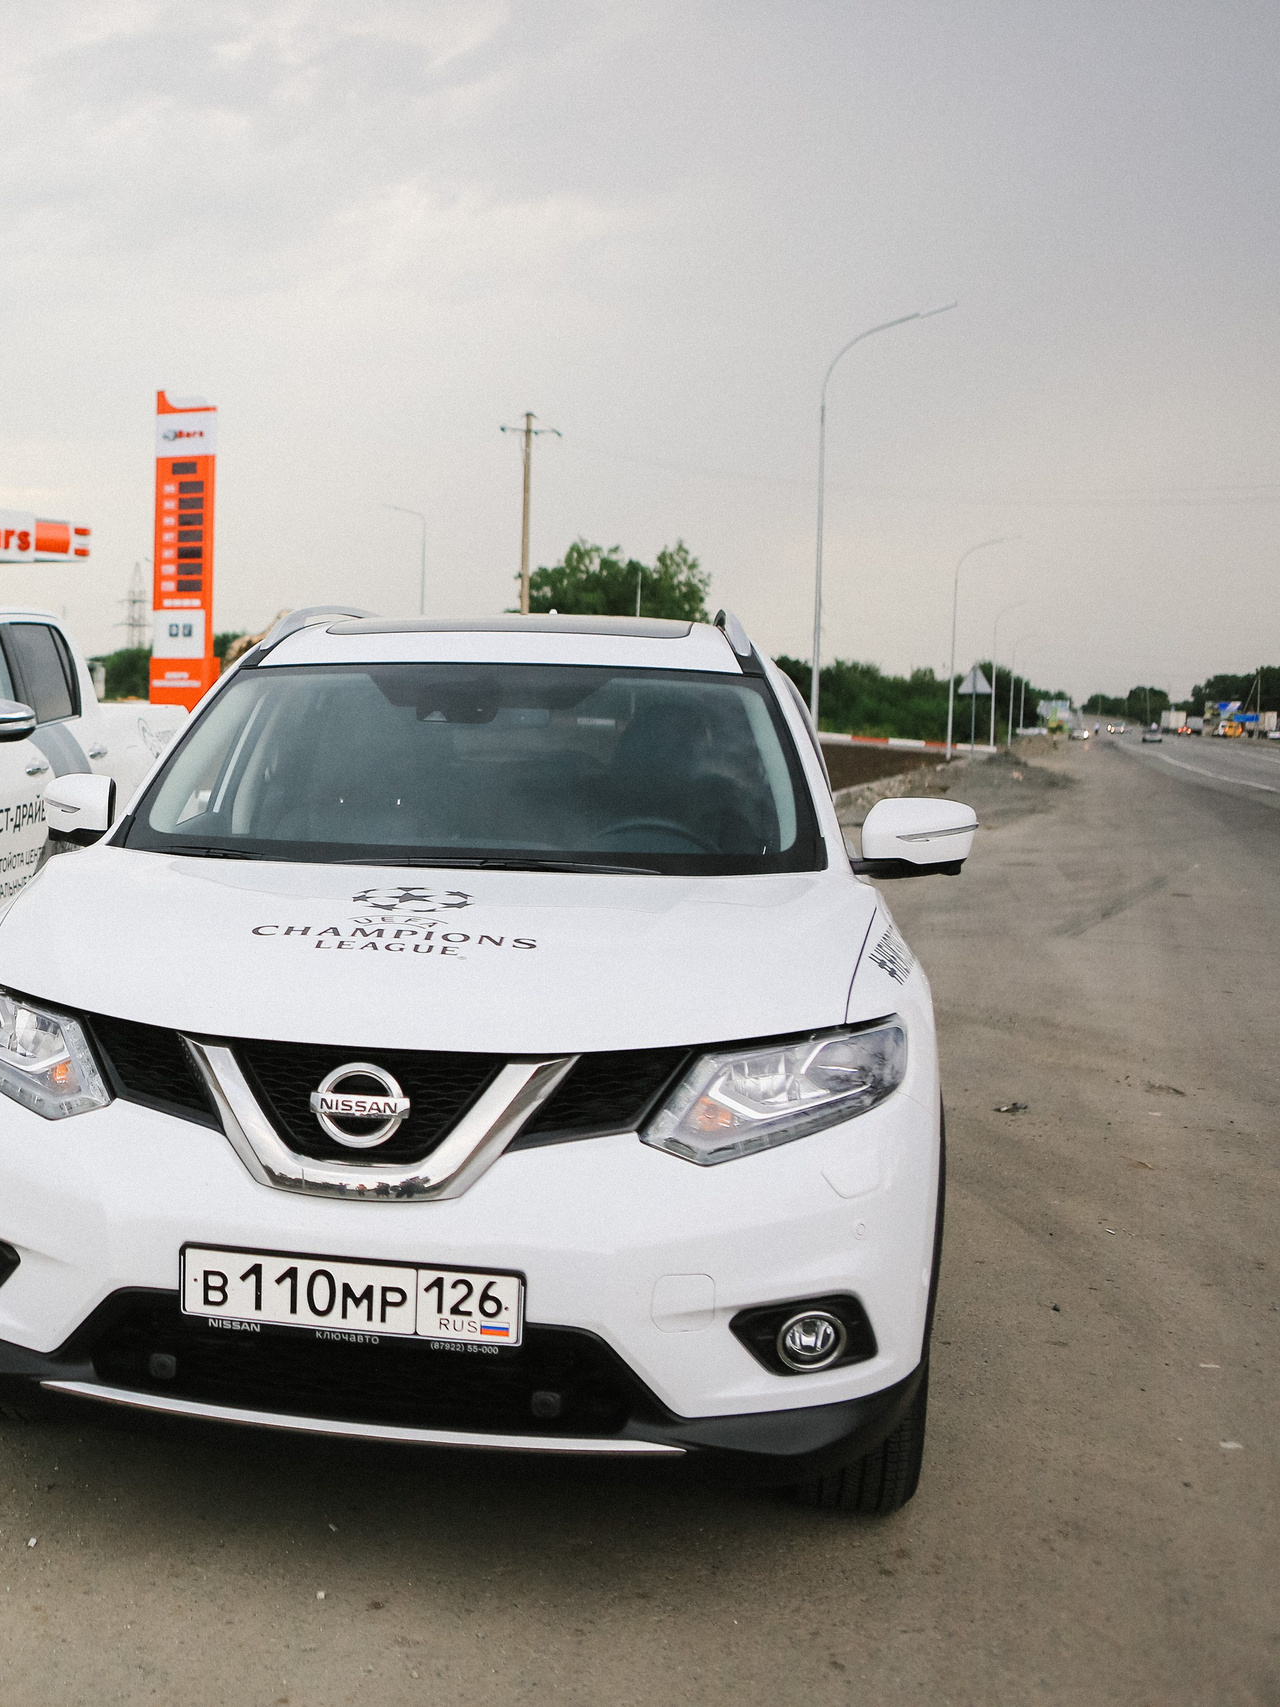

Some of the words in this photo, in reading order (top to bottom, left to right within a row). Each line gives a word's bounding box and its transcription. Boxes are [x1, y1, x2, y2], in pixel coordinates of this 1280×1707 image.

[353, 916, 437, 928] UEFA
[251, 925, 538, 950] CHAMPIONS
[315, 939, 460, 957] LEAGUE
[320, 1097, 397, 1114] NISSAN
[202, 1263, 408, 1323] В110МР
[423, 1276, 503, 1319] 126
[208, 1318, 261, 1333] NISSAN
[439, 1317, 478, 1334] RUS
[315, 1331, 380, 1345] ключавто
[430, 1341, 465, 1352] (87922)
[466, 1344, 499, 1355] 55-000
